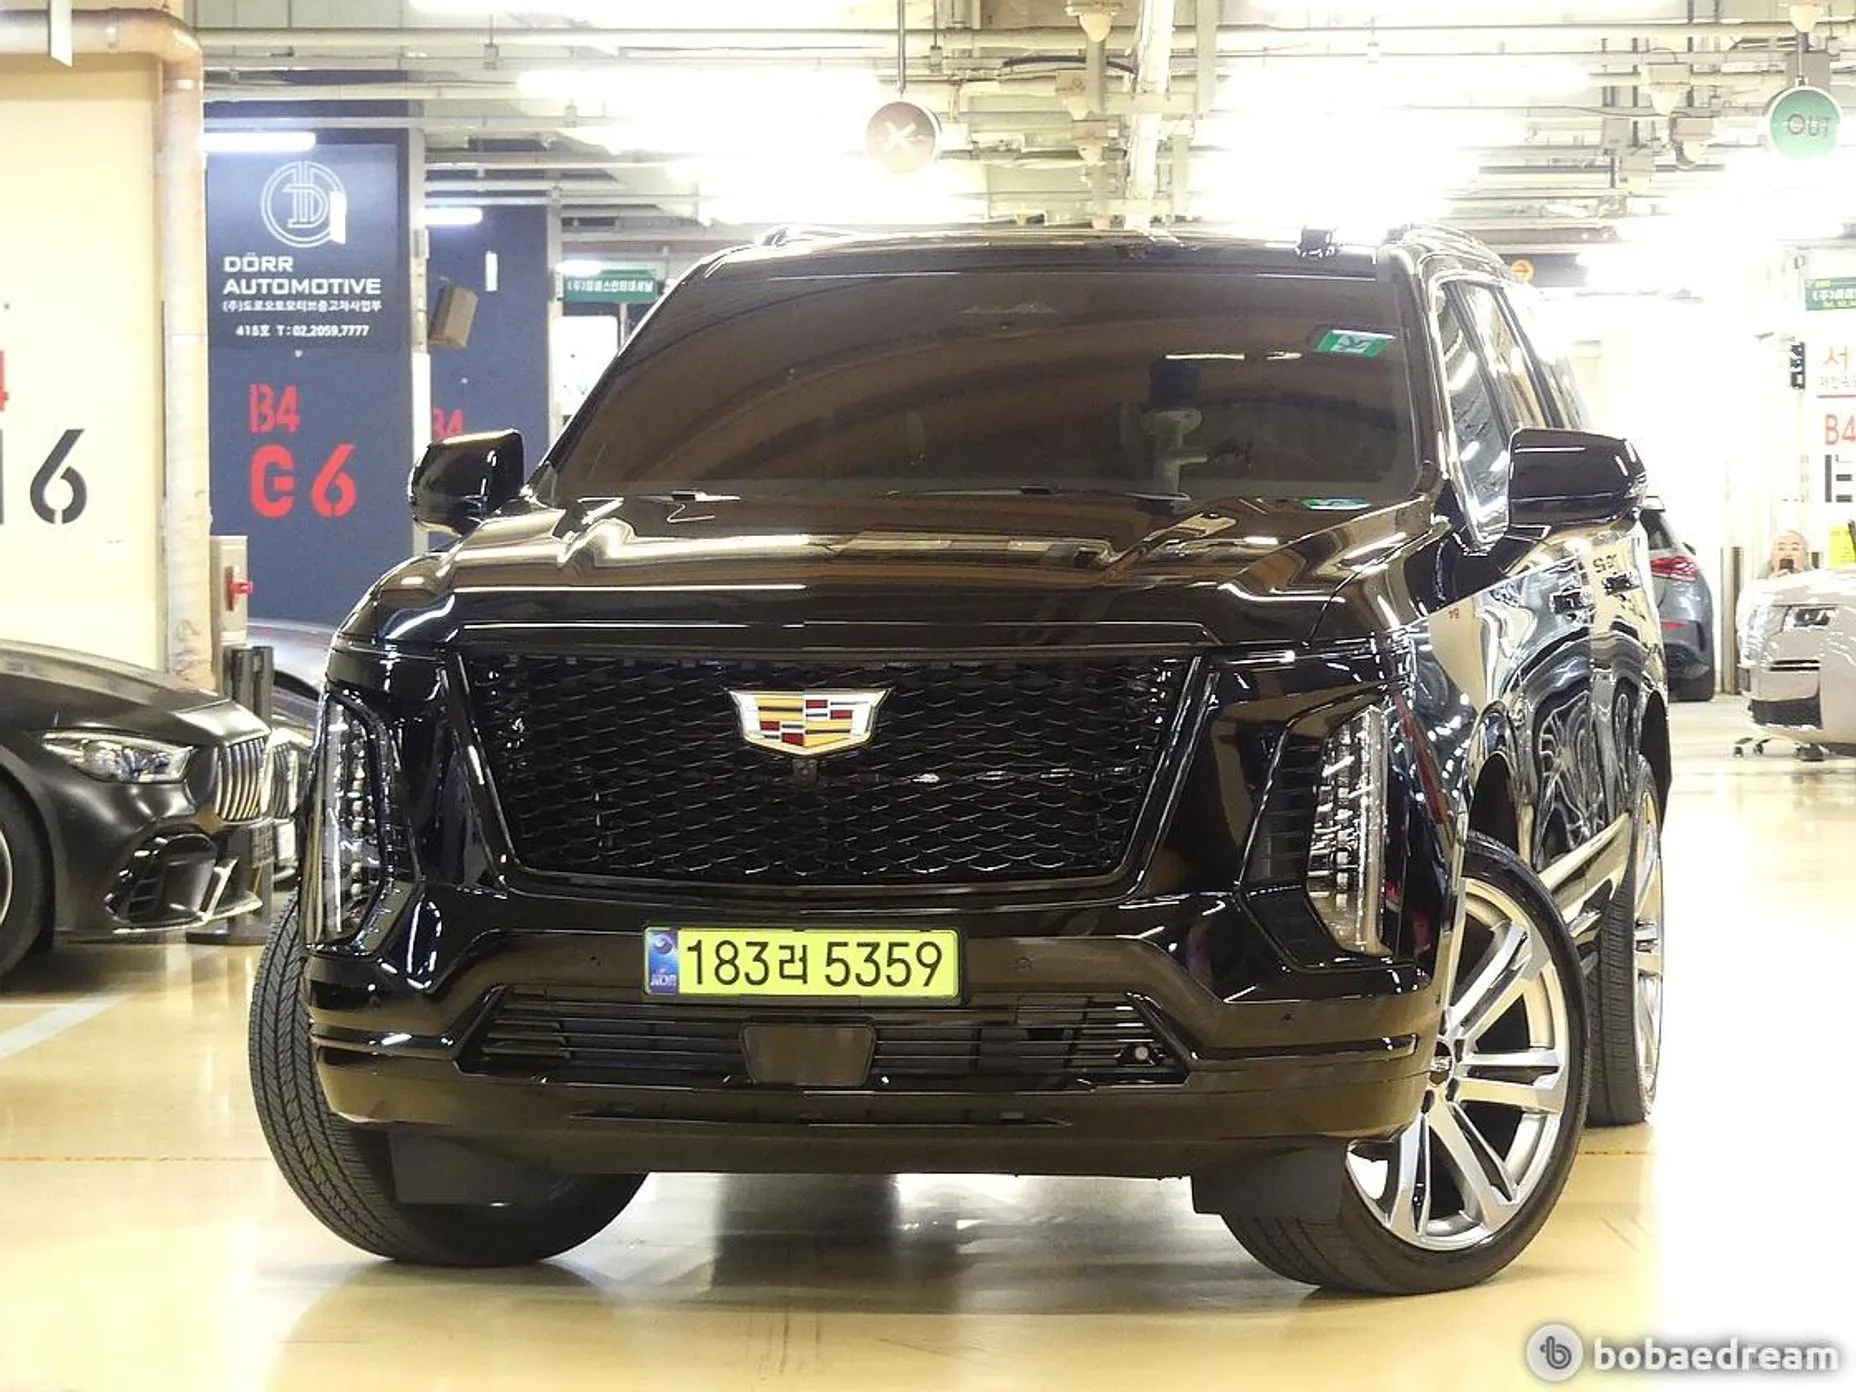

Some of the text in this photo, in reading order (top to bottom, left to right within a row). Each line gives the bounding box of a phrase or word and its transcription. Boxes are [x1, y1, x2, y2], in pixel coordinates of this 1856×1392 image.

[223, 252, 294, 273] DÖRR
[223, 278, 381, 295] AUTOMOTIVE
[249, 383, 299, 434] B4
[687, 939, 943, 988] 183러 5359
